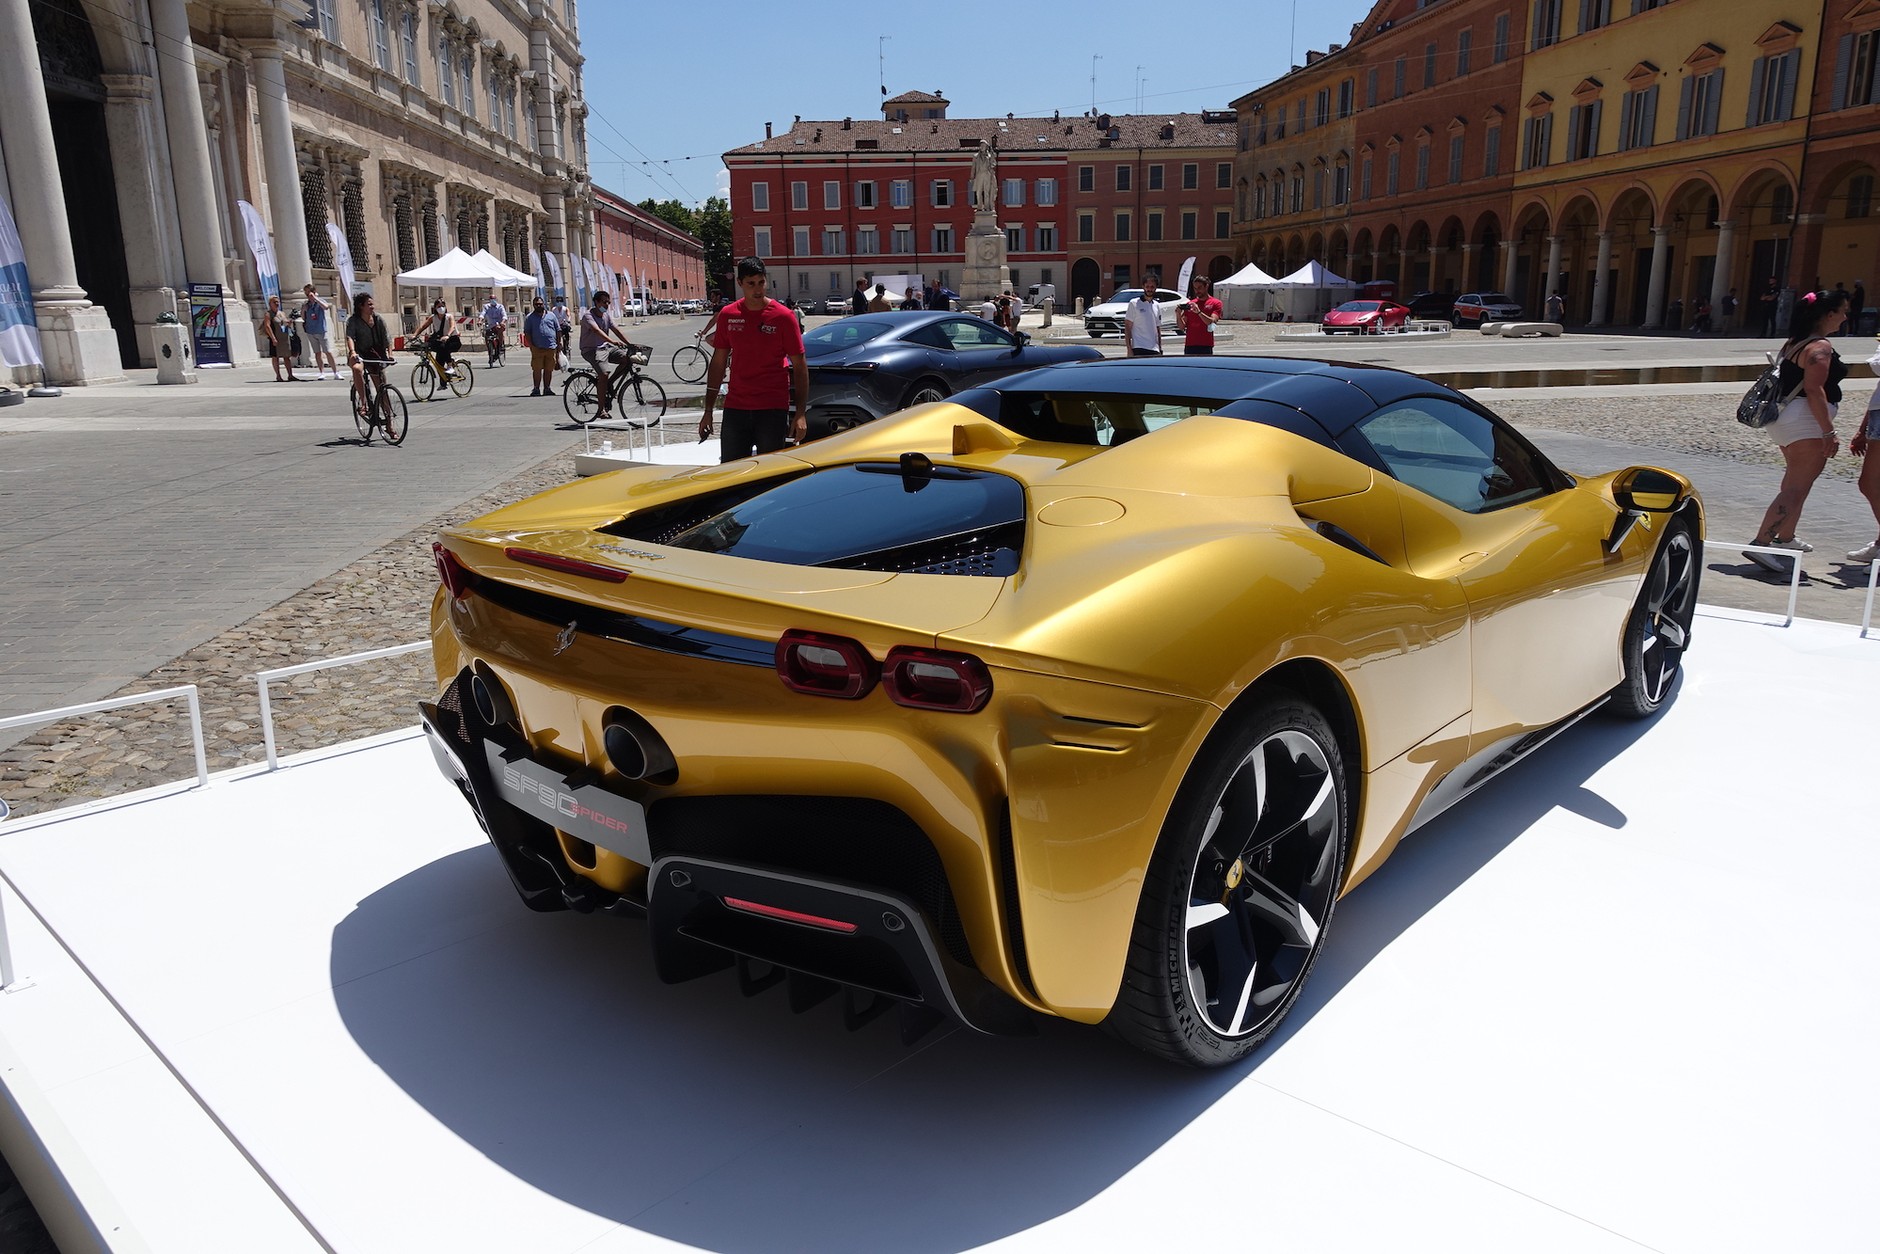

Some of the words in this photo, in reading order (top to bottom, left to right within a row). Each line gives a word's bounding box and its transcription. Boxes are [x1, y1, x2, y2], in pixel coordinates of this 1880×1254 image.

[503, 765, 579, 818] SF90
[570, 802, 628, 833] SPIDER
[1169, 906, 1180, 993] MICHELIN
